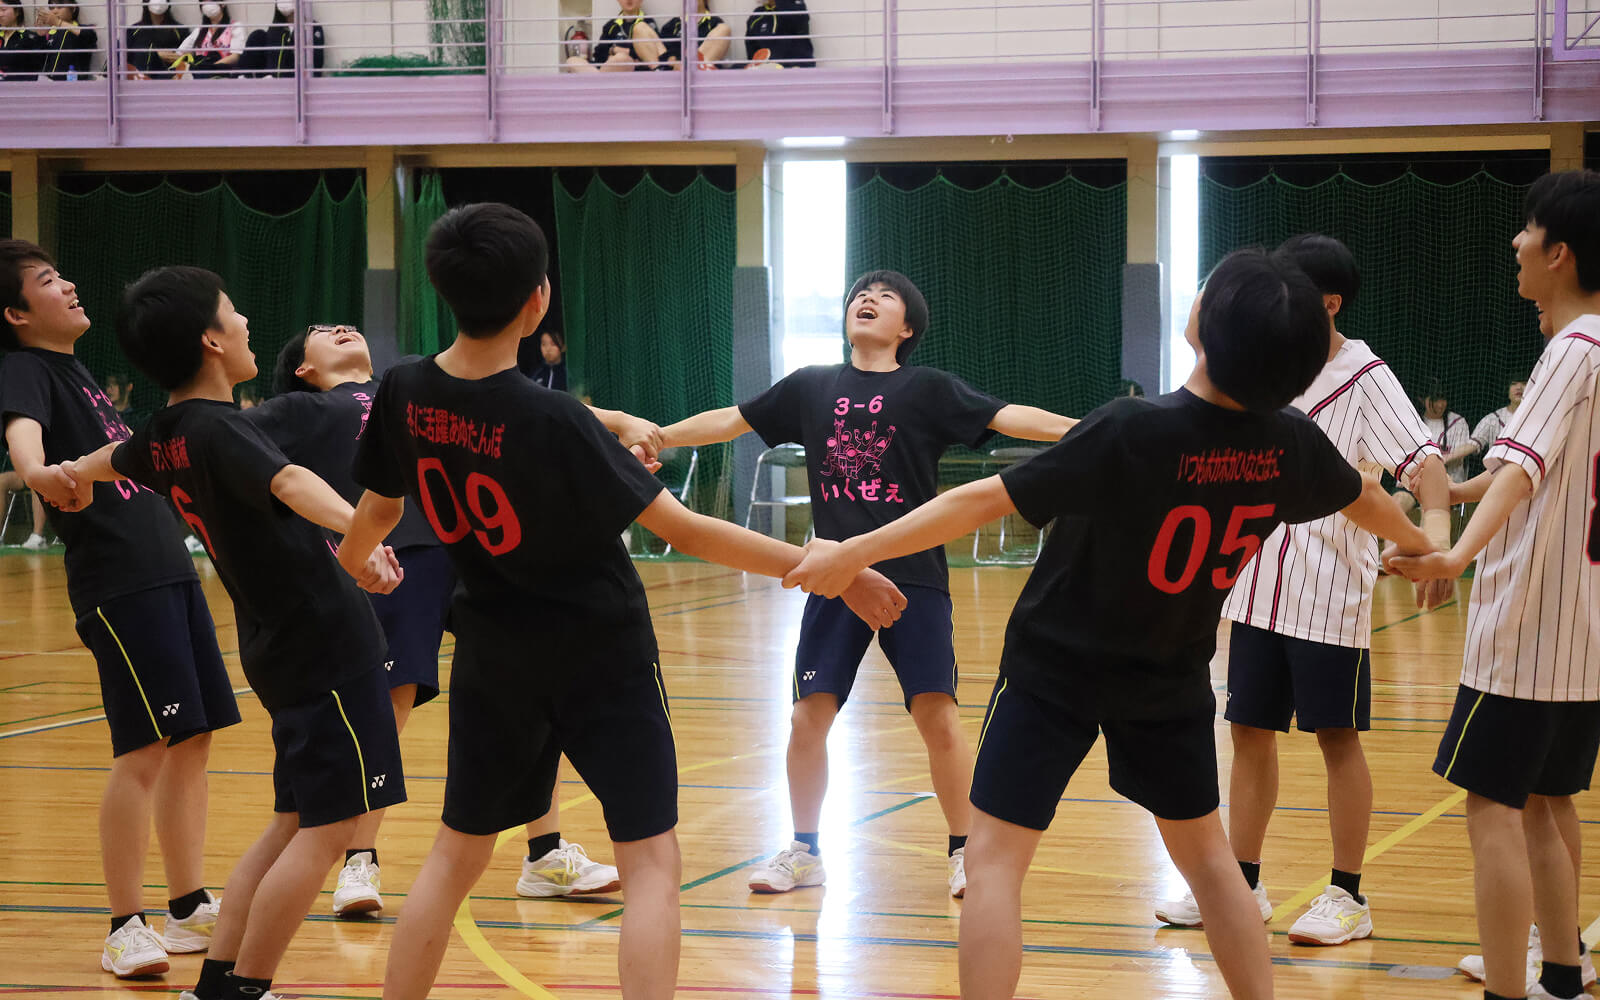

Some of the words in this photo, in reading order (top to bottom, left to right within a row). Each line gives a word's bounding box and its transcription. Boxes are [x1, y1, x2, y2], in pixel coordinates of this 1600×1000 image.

[833, 394, 884, 416] 3-6
[416, 457, 523, 557] 09
[1147, 503, 1277, 595] 05
